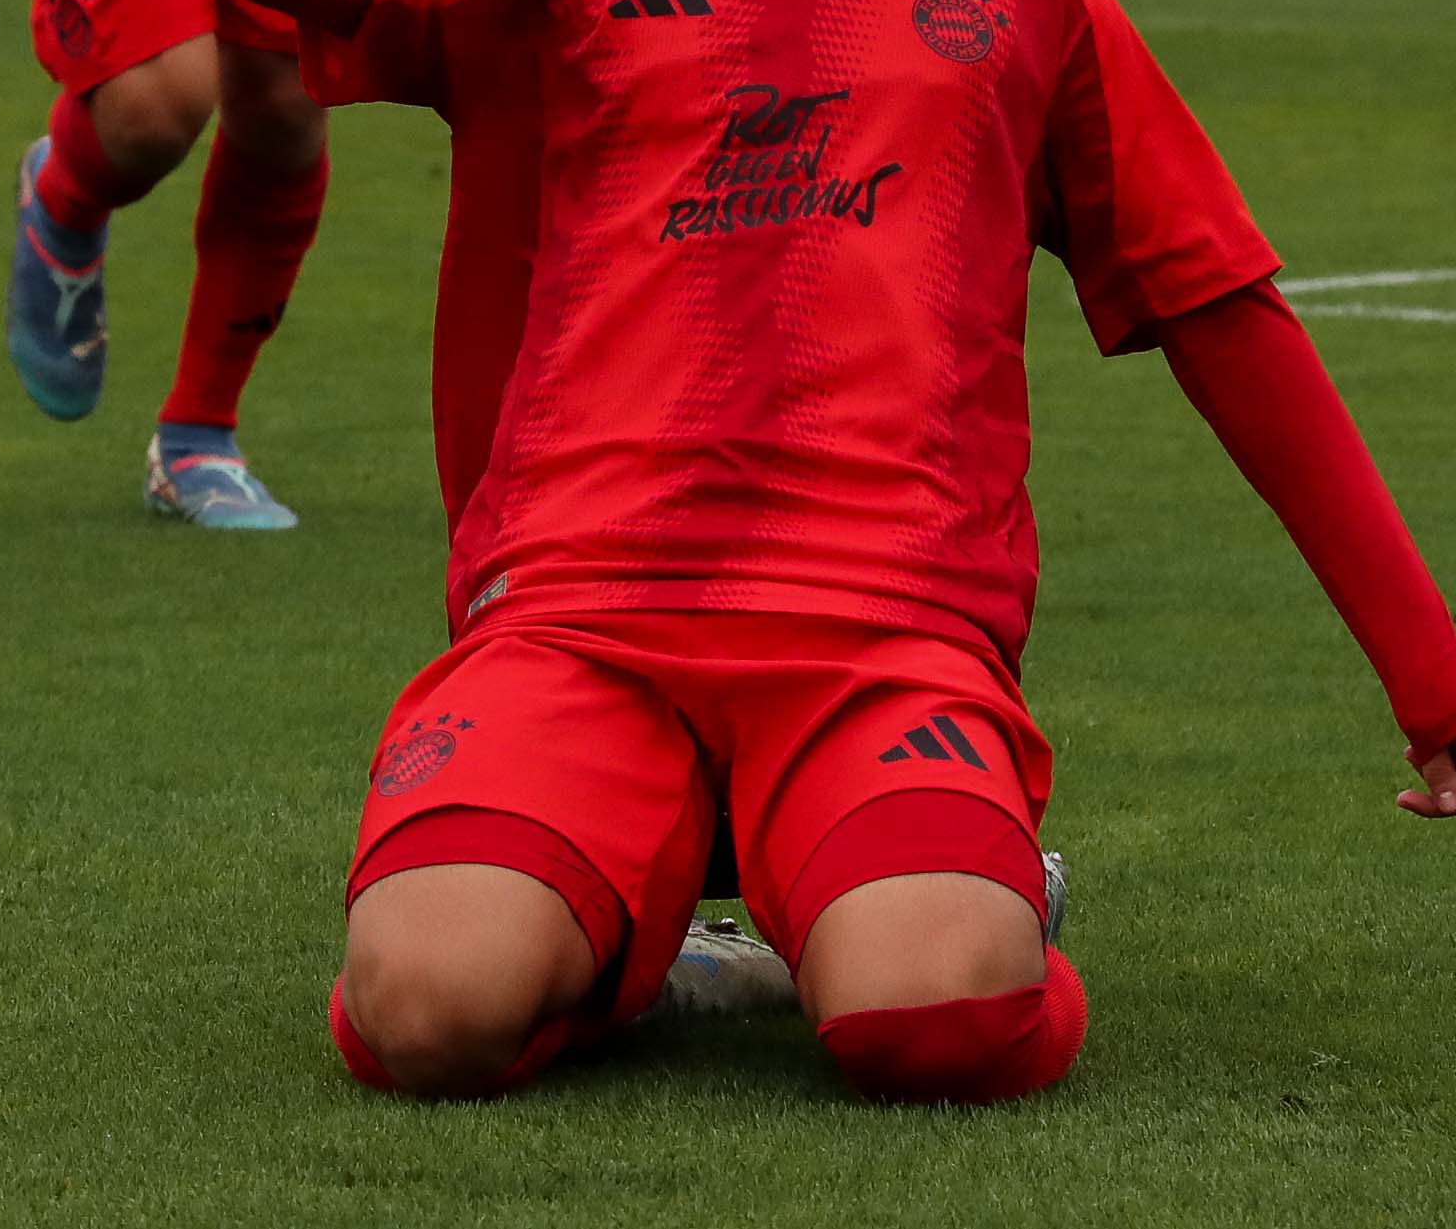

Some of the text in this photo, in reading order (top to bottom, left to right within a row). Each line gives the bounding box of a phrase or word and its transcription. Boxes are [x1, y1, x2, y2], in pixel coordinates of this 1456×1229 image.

[720, 83, 850, 151] ROT
[705, 124, 832, 190] GEGEN
[659, 162, 903, 243] RASSISMUS
